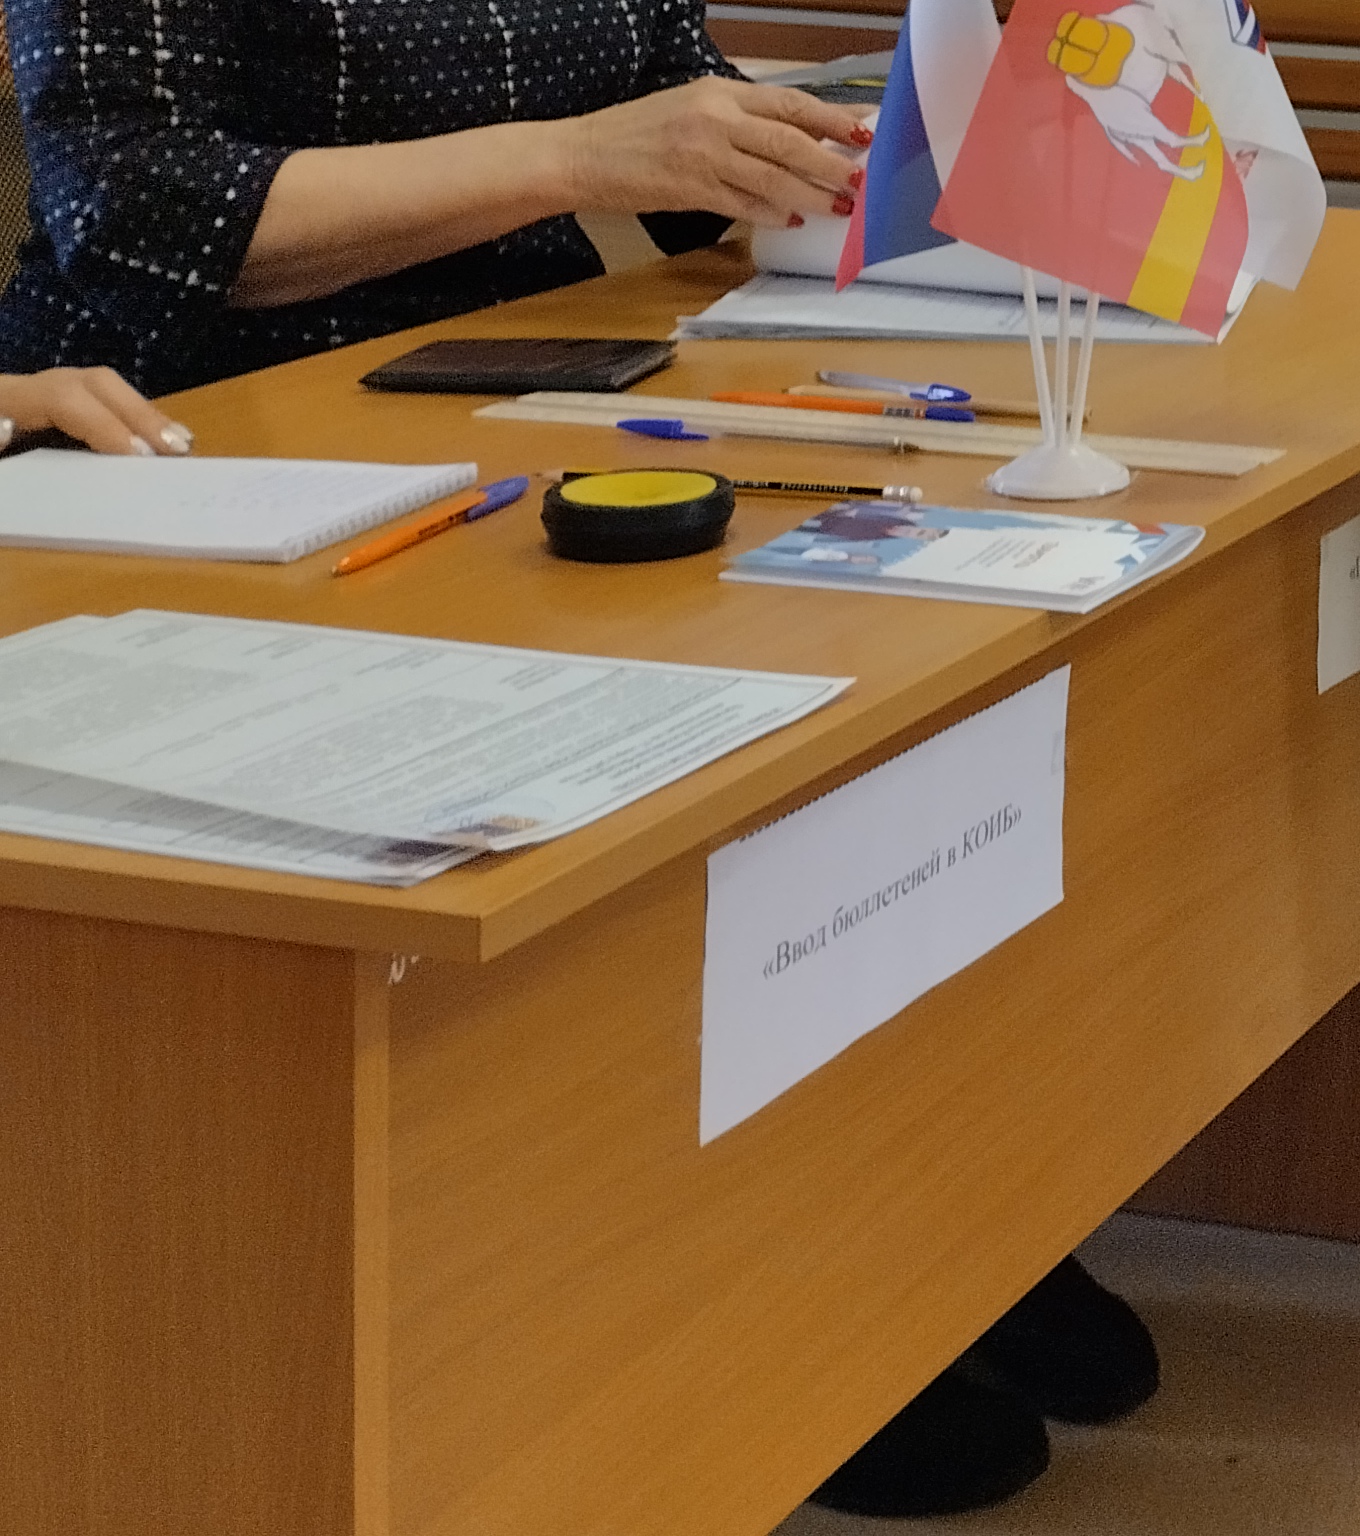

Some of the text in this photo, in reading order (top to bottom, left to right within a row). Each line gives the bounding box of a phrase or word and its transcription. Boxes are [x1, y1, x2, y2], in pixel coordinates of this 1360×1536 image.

[763, 802, 1022, 980] «Ввод бюллетеней в КОИБ»
